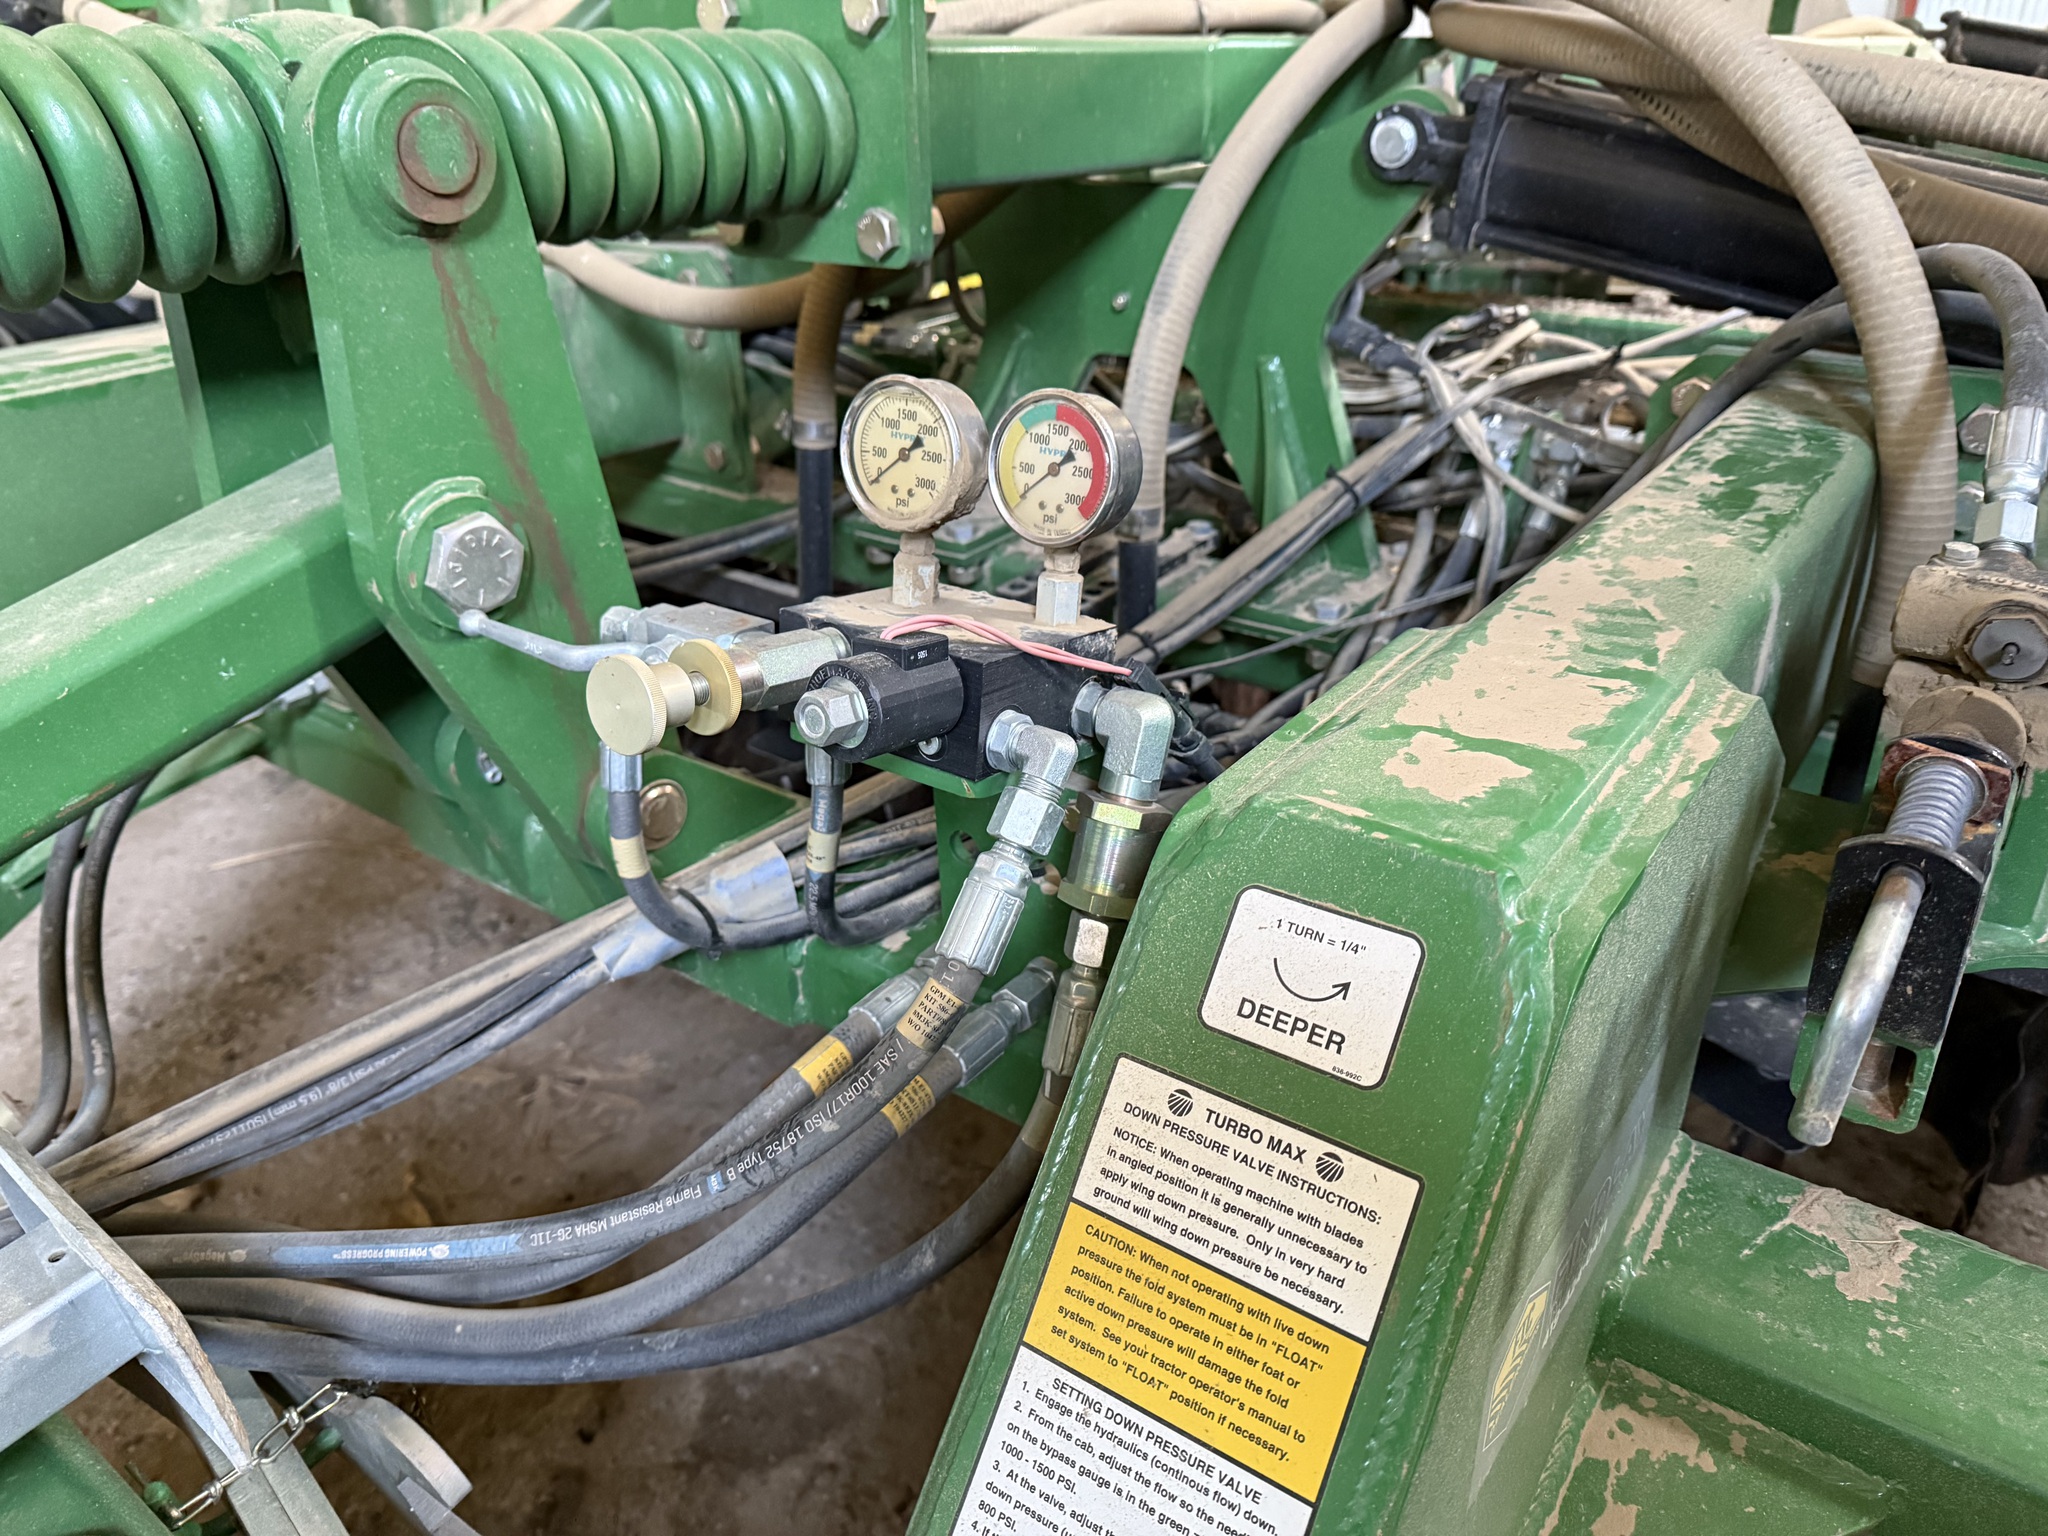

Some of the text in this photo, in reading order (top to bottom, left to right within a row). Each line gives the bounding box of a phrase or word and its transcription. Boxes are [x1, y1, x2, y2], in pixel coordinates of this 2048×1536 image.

[881, 417, 901, 431] 1000
[897, 408, 917, 422] 1500
[917, 424, 938, 437] 2000
[1029, 433, 1050, 446] 1000
[1047, 423, 1069, 437] 1500
[872, 446, 887, 458] 500
[921, 450, 942, 464] 2500
[1019, 463, 1035, 474] 500
[1072, 466, 1093, 479] 2500
[915, 477, 936, 491] 3000
[896, 497, 910, 508] psi
[1043, 513, 1058, 525] psi
[1276, 919, 1366, 955] 1 TURN = 1/4"
[924, 992, 938, 1007] KIT
[929, 985, 947, 1000] GPM
[1237, 997, 1346, 1055] DEEPER
[873, 1048, 898, 1075] SAE
[804, 1110, 826, 1133] ISO
[766, 1126, 804, 1159] 18752
[1205, 1107, 1307, 1164] TURBO MAX
[726, 1167, 737, 1181] B
[738, 1153, 767, 1172] Type
[1123, 1101, 1382, 1225] DOWN PRESSURE VALVE INSTRUCTIONS:
[666, 1184, 702, 1209] Flame
[1113, 1126, 1364, 1249] NOTICE: When operating machine with blades
[610, 1202, 664, 1227] Resistant
[1106, 1145, 1367, 1275] in angled position it is generally unnecessary to
[575, 1218, 608, 1238] MSHA
[1099, 1167, 1346, 1289] apply wing down pressure. Only in very hard
[384, 1246, 427, 1258] POWERING
[1092, 1186, 1344, 1314] ground will wing down pressure be necessary.
[1085, 1224, 1329, 1354] CAUTION: When not operating with live down
[1077, 1245, 1323, 1372] pressure the fold system must be in "FLOAT"
[1070, 1265, 1300, 1389] position. Failure to operate in either foat or
[1064, 1285, 1289, 1409] active down pressure will damage the fold
[1057, 1305, 1305, 1443] system. See your tractor operator's manual to
[1050, 1325, 1289, 1462] set system to "FLOAT" position if necessary.
[1052, 1377, 1262, 1505] SETTING DOWN PRESSURE VALVE
[1000, 1440, 1024, 1461] 1000
[1032, 1459, 1056, 1480] 1500
[1056, 1473, 1076, 1495] PSI.
[1013, 1399, 1214, 1525] 2. From the cab, adjust the flow so the
[1022, 1380, 1029, 1393] 1.
[1034, 1387, 1073, 1417] Engage
[1075, 1411, 1092, 1428] the
[1093, 1421, 1149, 1461] hydraulics
[1150, 1454, 1210, 1497] (continous
[1212, 1490, 1241, 1517] flow)
[1243, 1509, 1278, 1536] down.
[1006, 1422, 1190, 1536] on the bypass gauge is in the green
